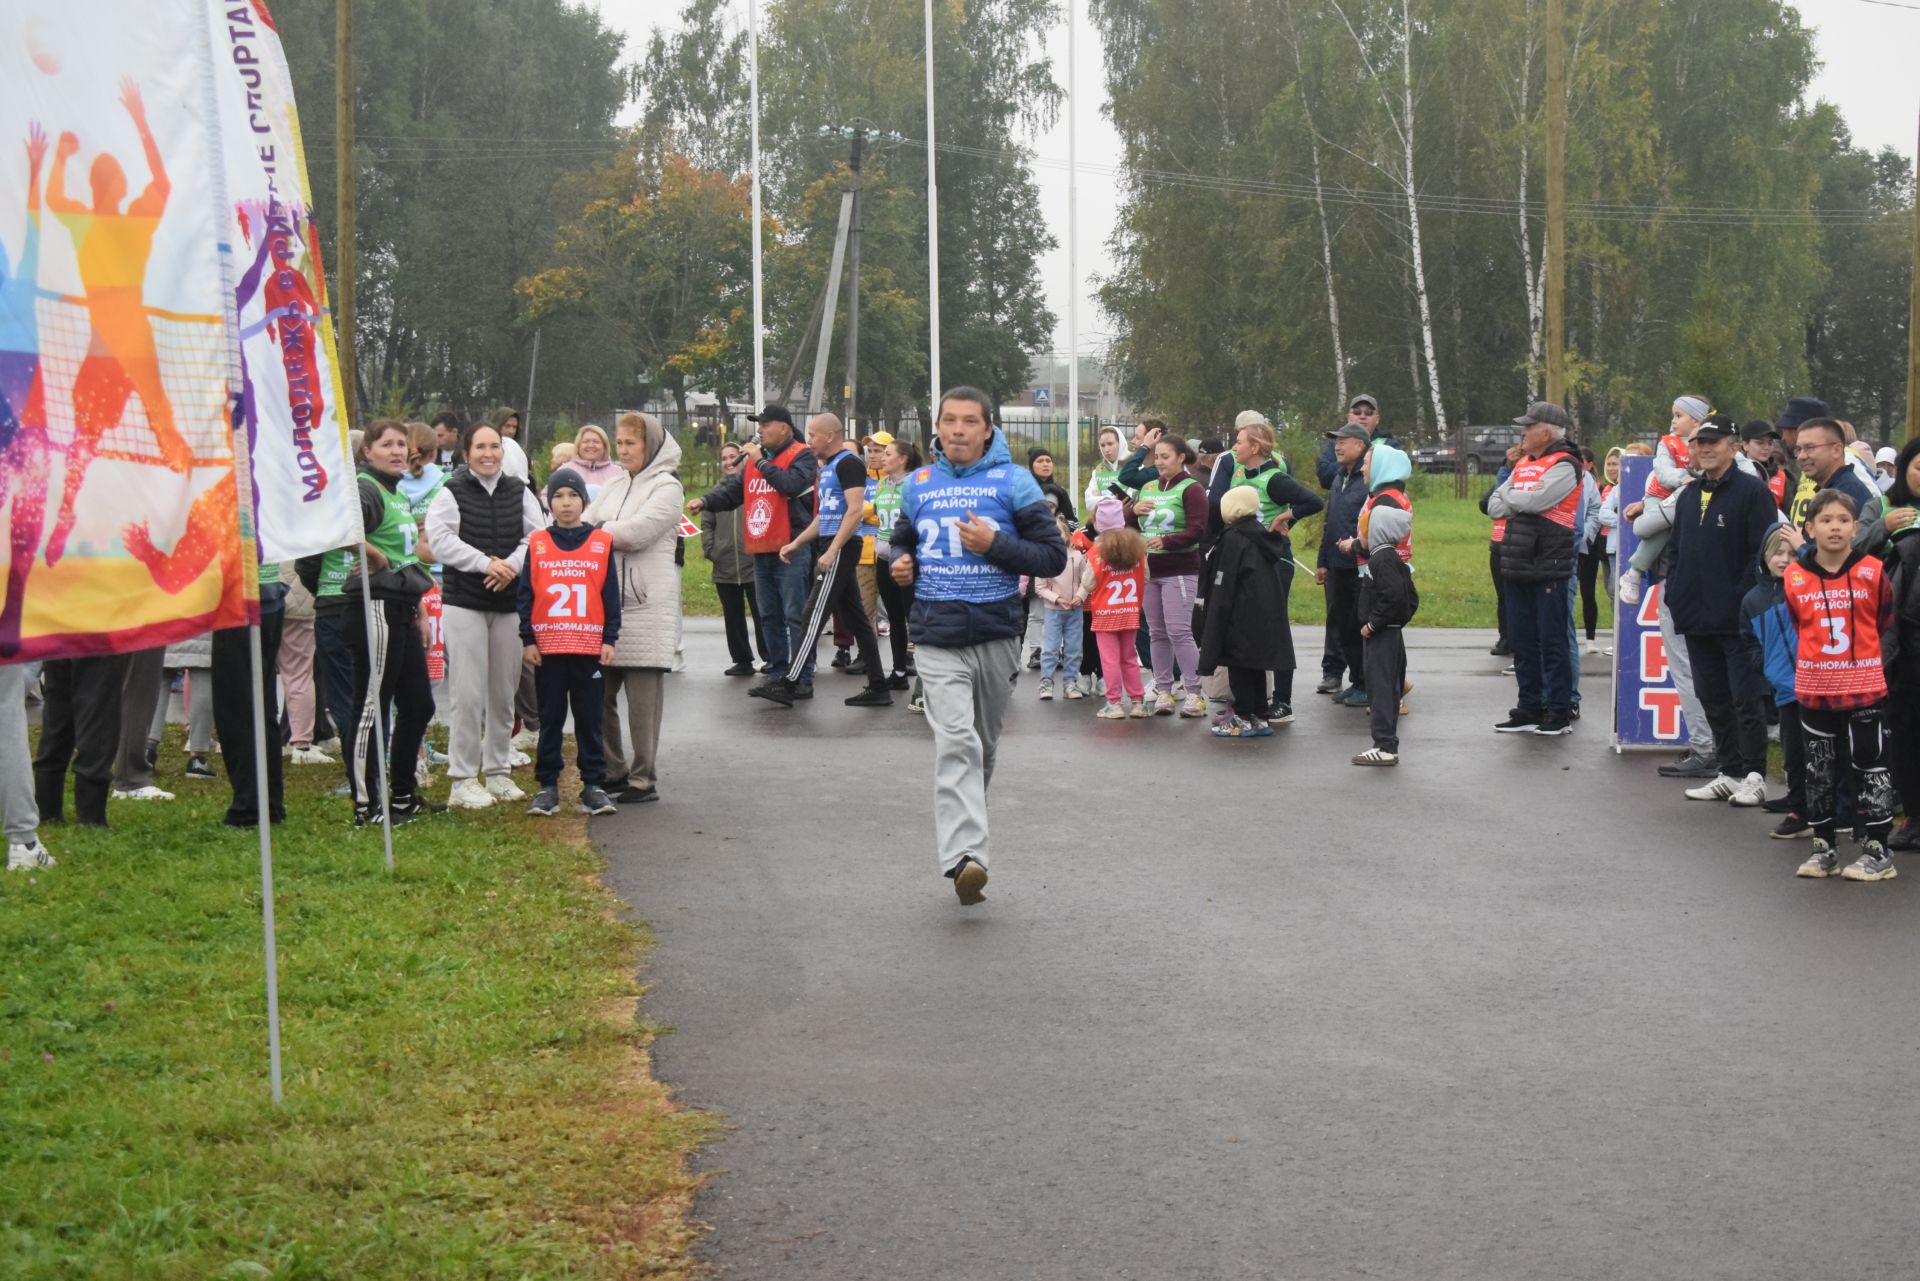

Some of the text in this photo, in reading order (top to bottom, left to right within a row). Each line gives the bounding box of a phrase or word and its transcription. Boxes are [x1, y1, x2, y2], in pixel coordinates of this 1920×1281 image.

[748, 478, 777, 495] СУДЬ
[918, 486, 997, 503] ТУКАЕВСКИЙ
[932, 497, 978, 510] РАЙОН
[917, 516, 1001, 560] 21
[538, 559, 599, 572] ТУКАЕВСКИЙ
[551, 567, 586, 578] РАЙОН
[939, 564, 979, 575] НОРМА
[1106, 578, 1139, 606] 22
[1797, 588, 1869, 604] ТУКАЕВСКИЙ
[546, 583, 587, 618] 21
[1814, 599, 1853, 611] РАЙОН
[554, 622, 583, 632] НОРМА
[1820, 616, 1850, 655] 3
